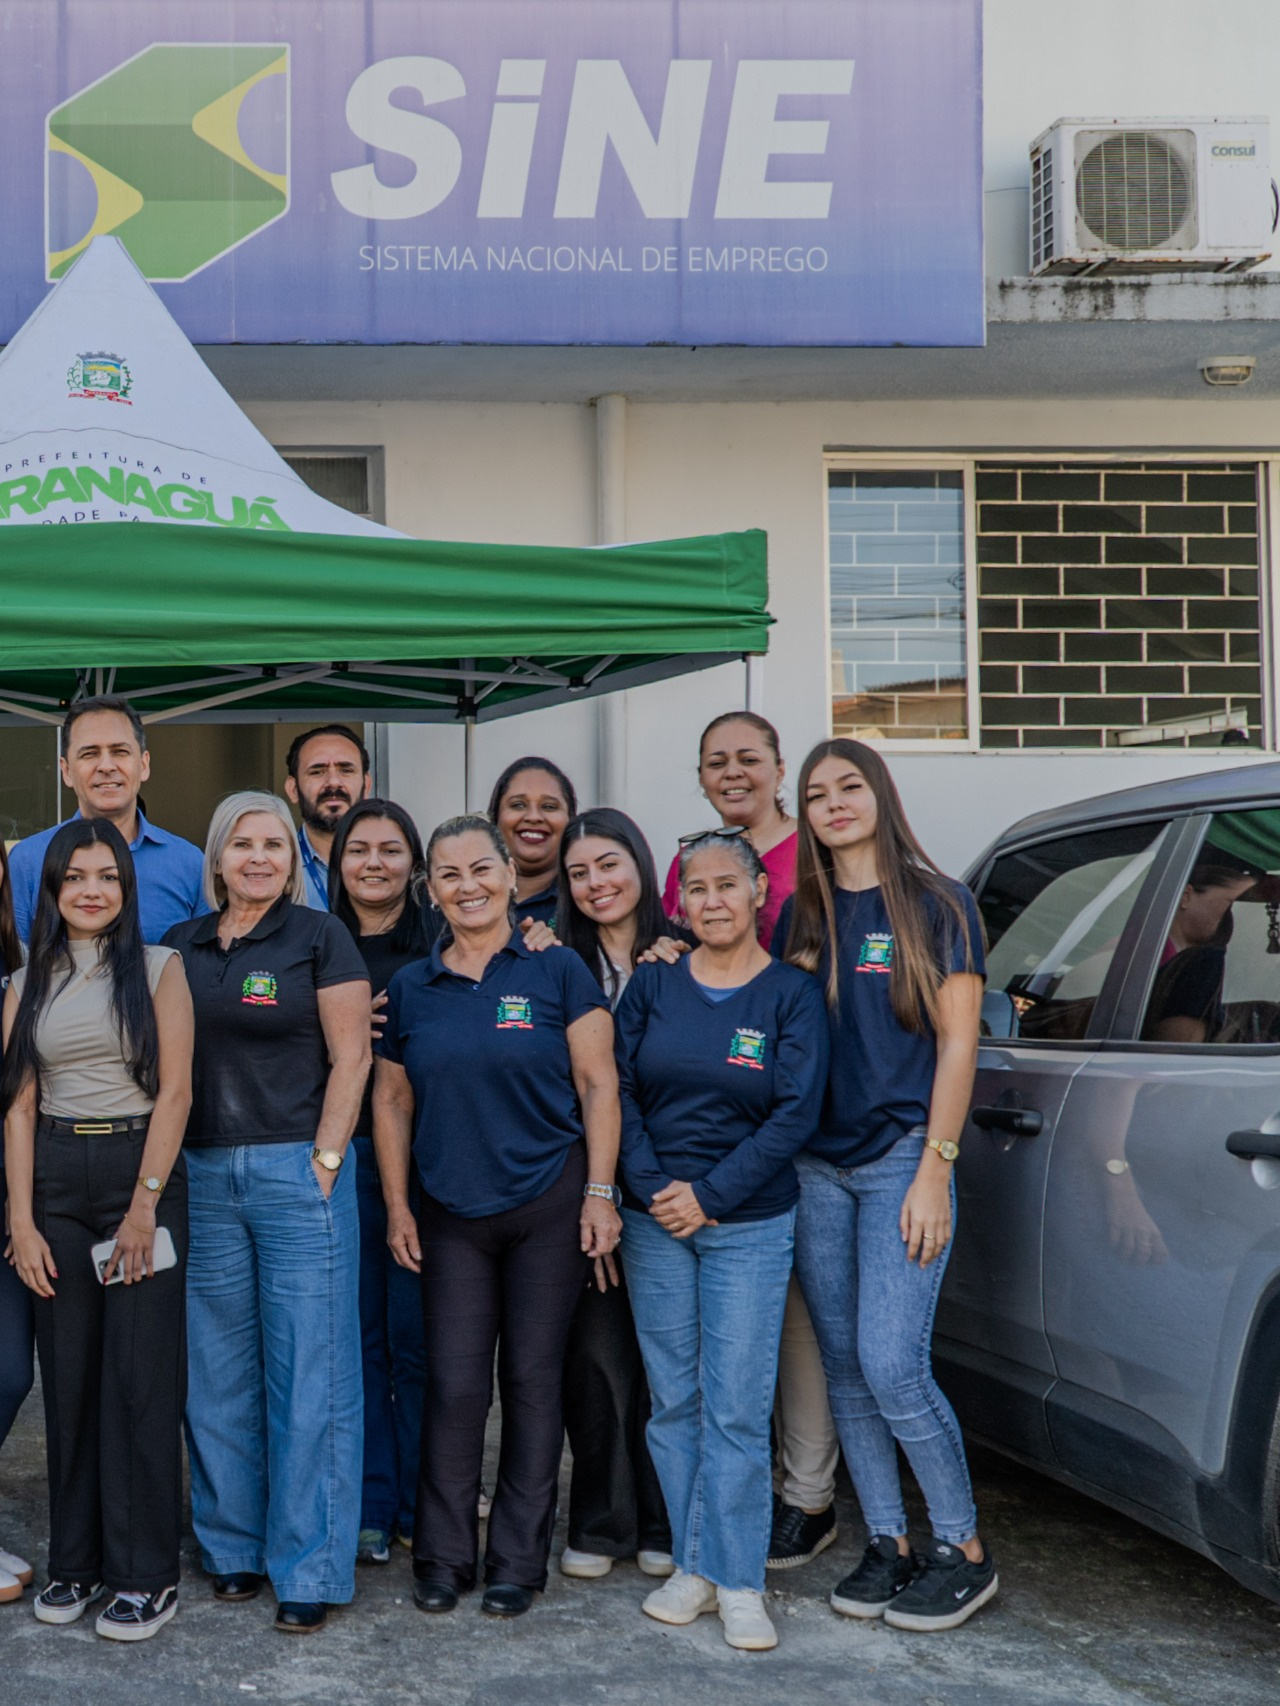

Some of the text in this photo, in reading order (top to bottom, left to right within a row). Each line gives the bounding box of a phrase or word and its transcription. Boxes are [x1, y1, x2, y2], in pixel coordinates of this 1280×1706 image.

[1211, 145, 1256, 157] Consul
[358, 245, 829, 272] SISTEMA NACIONAL DE EMPREGO
[4, 451, 207, 485] PREFEITURA DE
